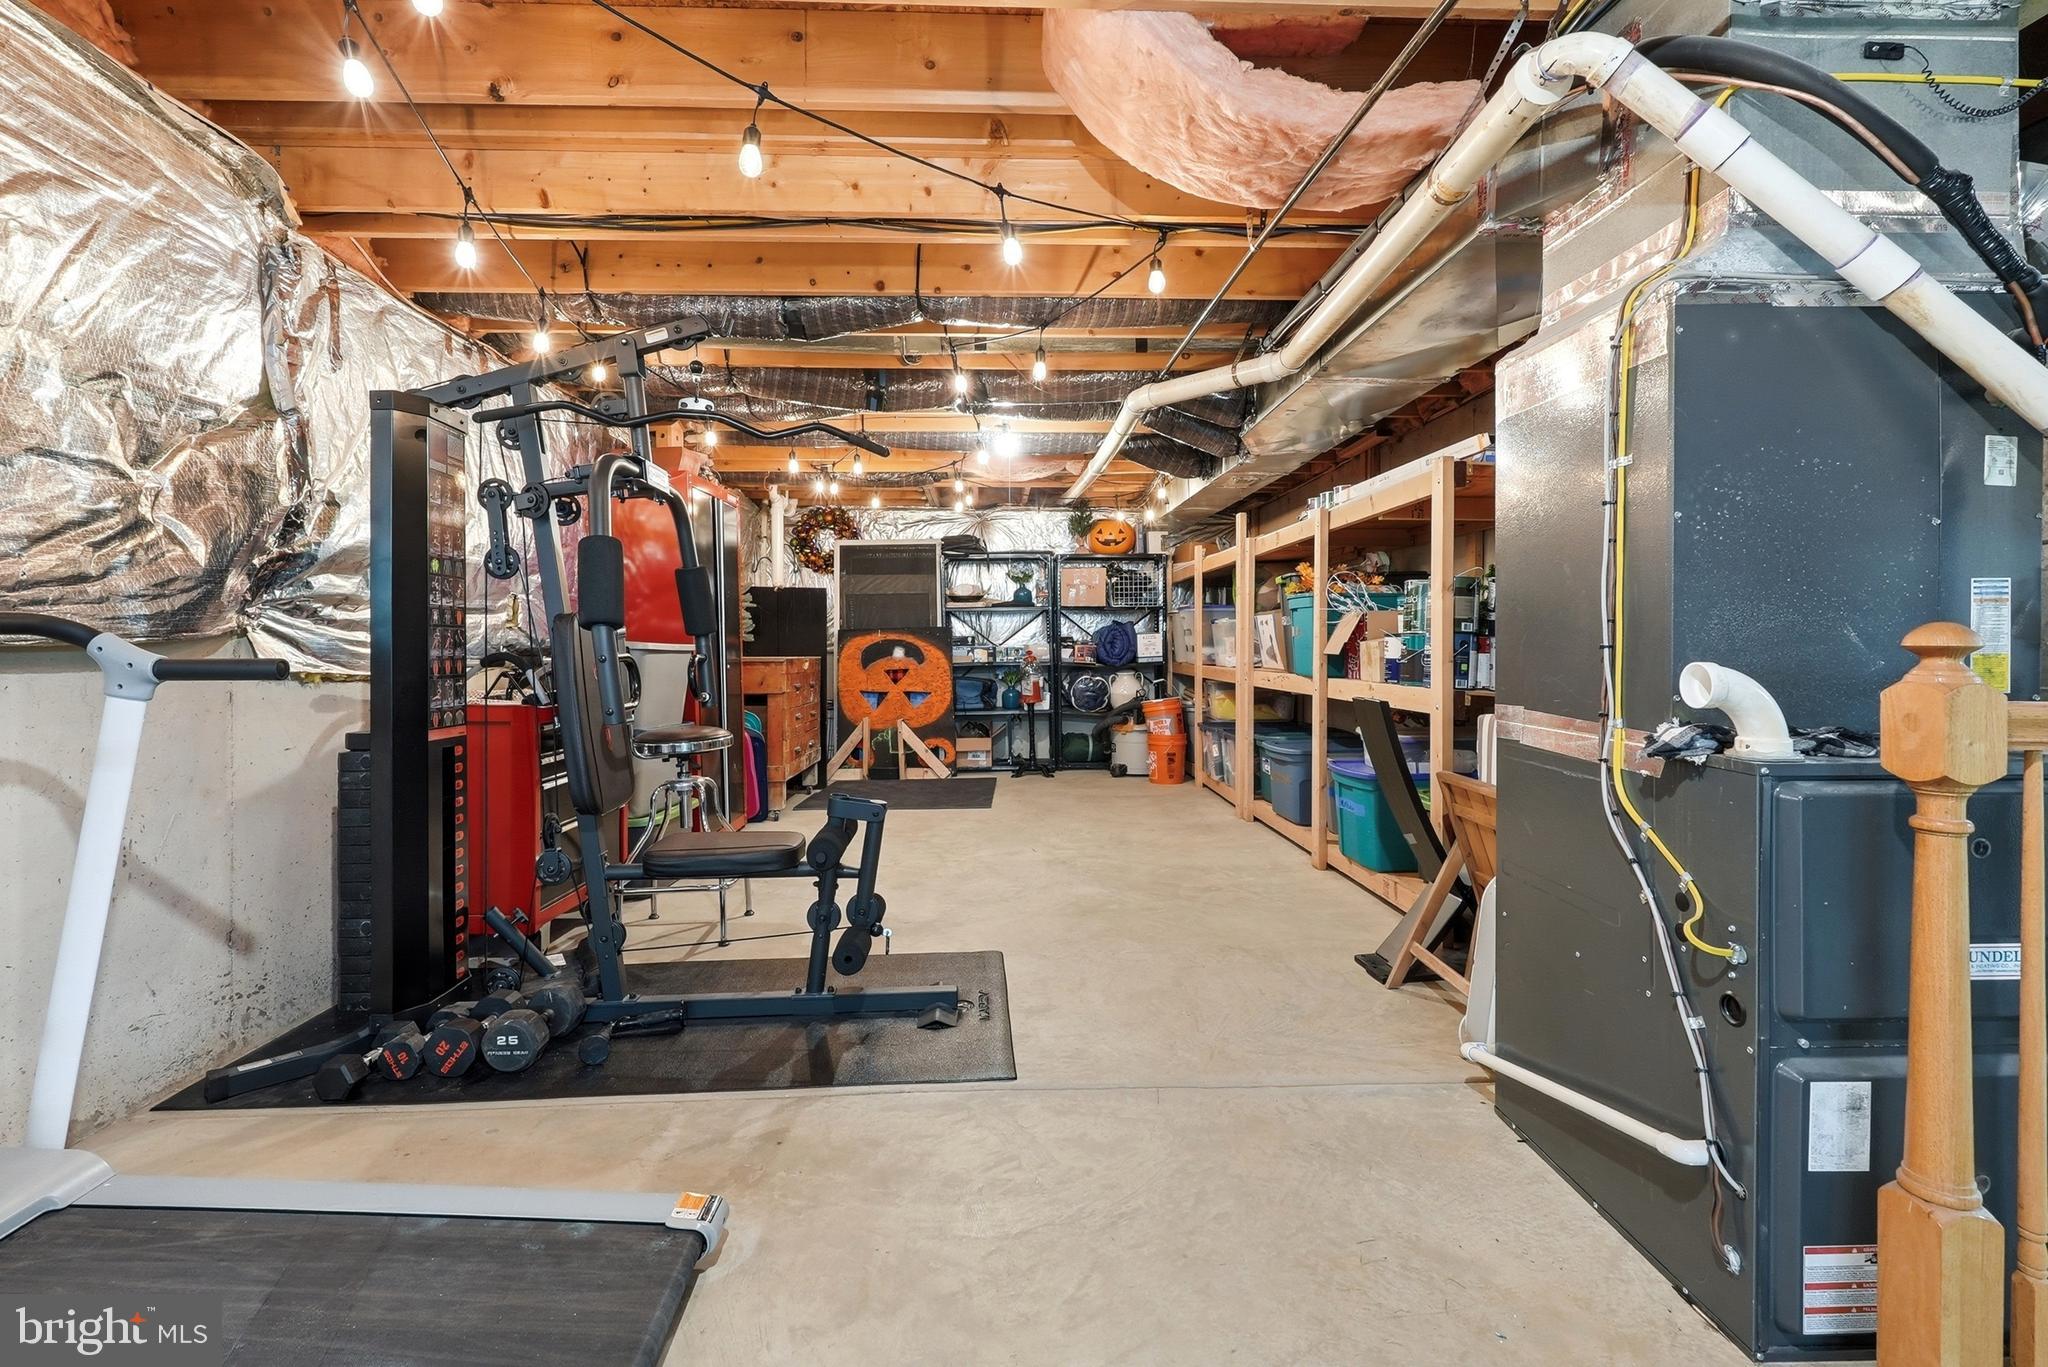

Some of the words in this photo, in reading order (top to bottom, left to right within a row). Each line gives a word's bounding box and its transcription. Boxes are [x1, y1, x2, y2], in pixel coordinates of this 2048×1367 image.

[435, 1040, 450, 1056] 20
[496, 1035, 519, 1046] 25
[383, 1050, 402, 1079] ETHOS
[397, 1051, 409, 1065] 10
[440, 1040, 469, 1074] ETHOS
